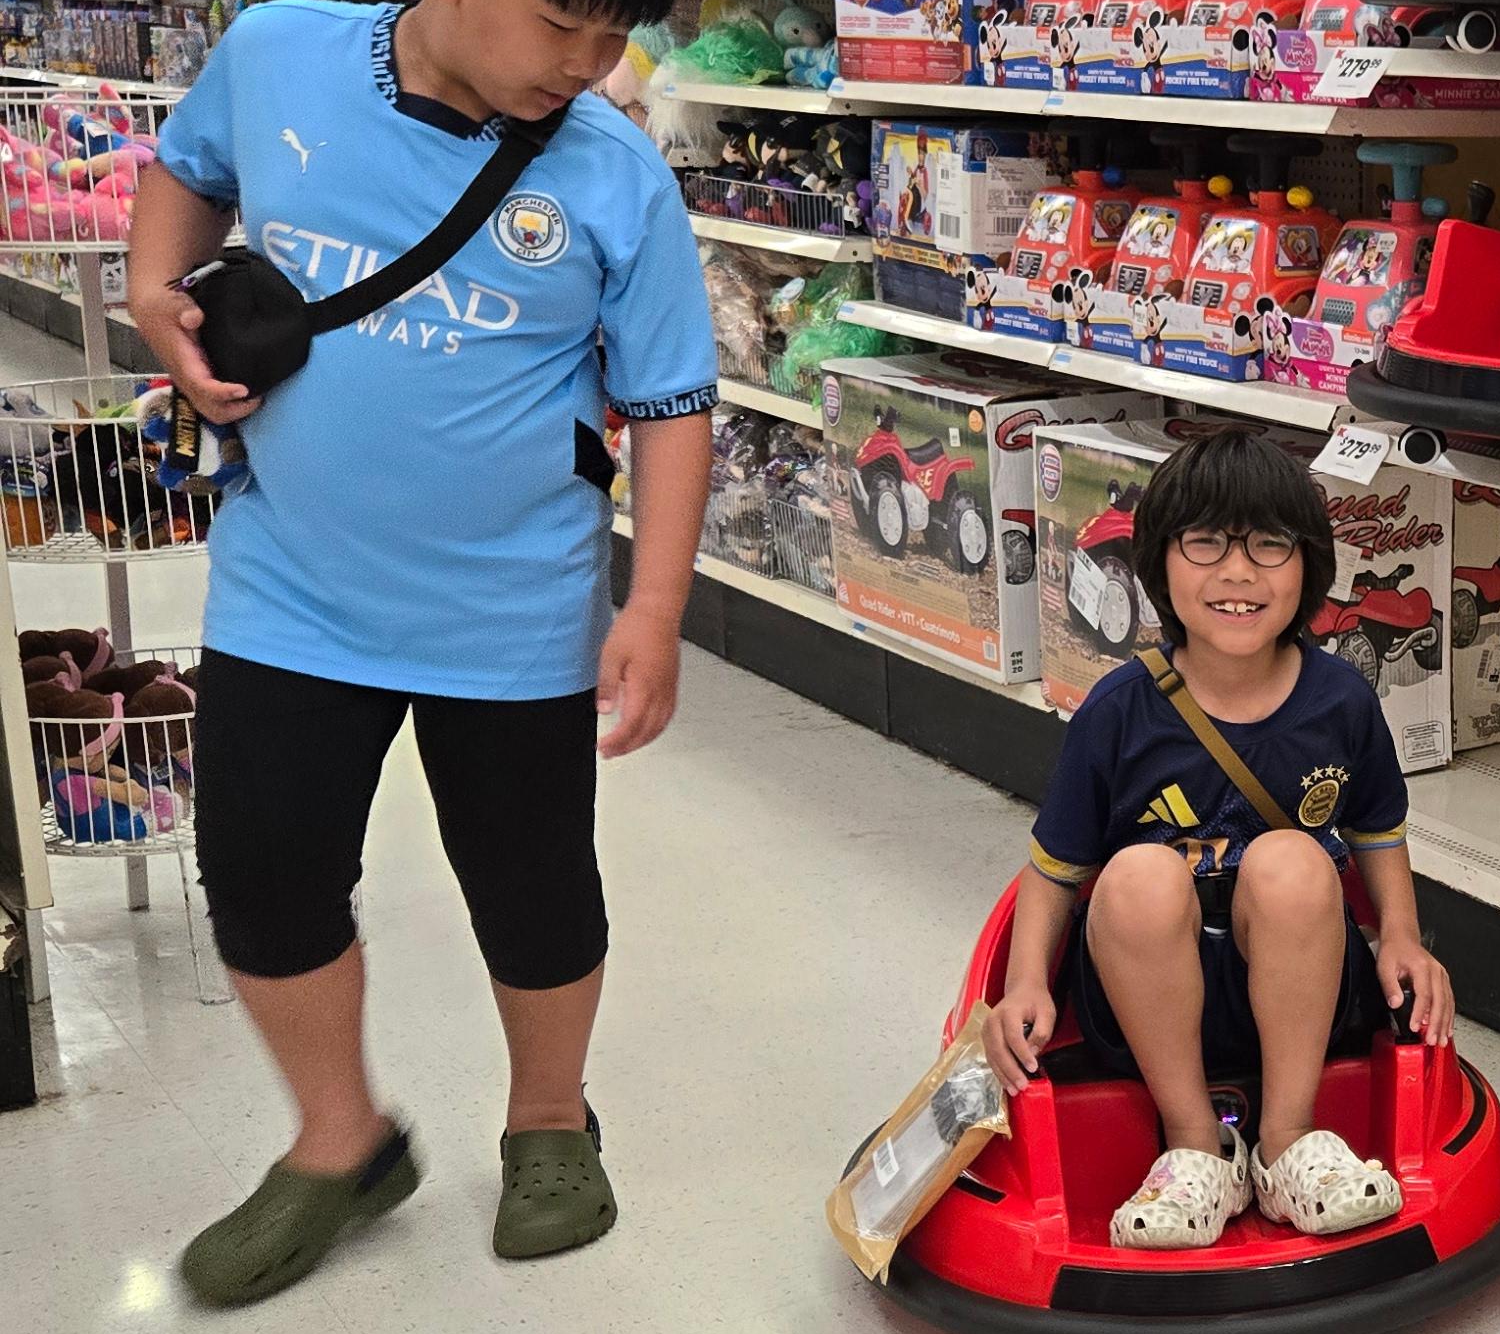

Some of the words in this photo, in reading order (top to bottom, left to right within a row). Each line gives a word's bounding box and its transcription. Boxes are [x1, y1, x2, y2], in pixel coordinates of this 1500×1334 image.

[504, 198, 561, 226] MANCHESTER
[516, 247, 540, 259] CITY
[356, 311, 464, 356] WAYS
[1334, 515, 1445, 560] Rider
[1010, 650, 1024, 658] 4W
